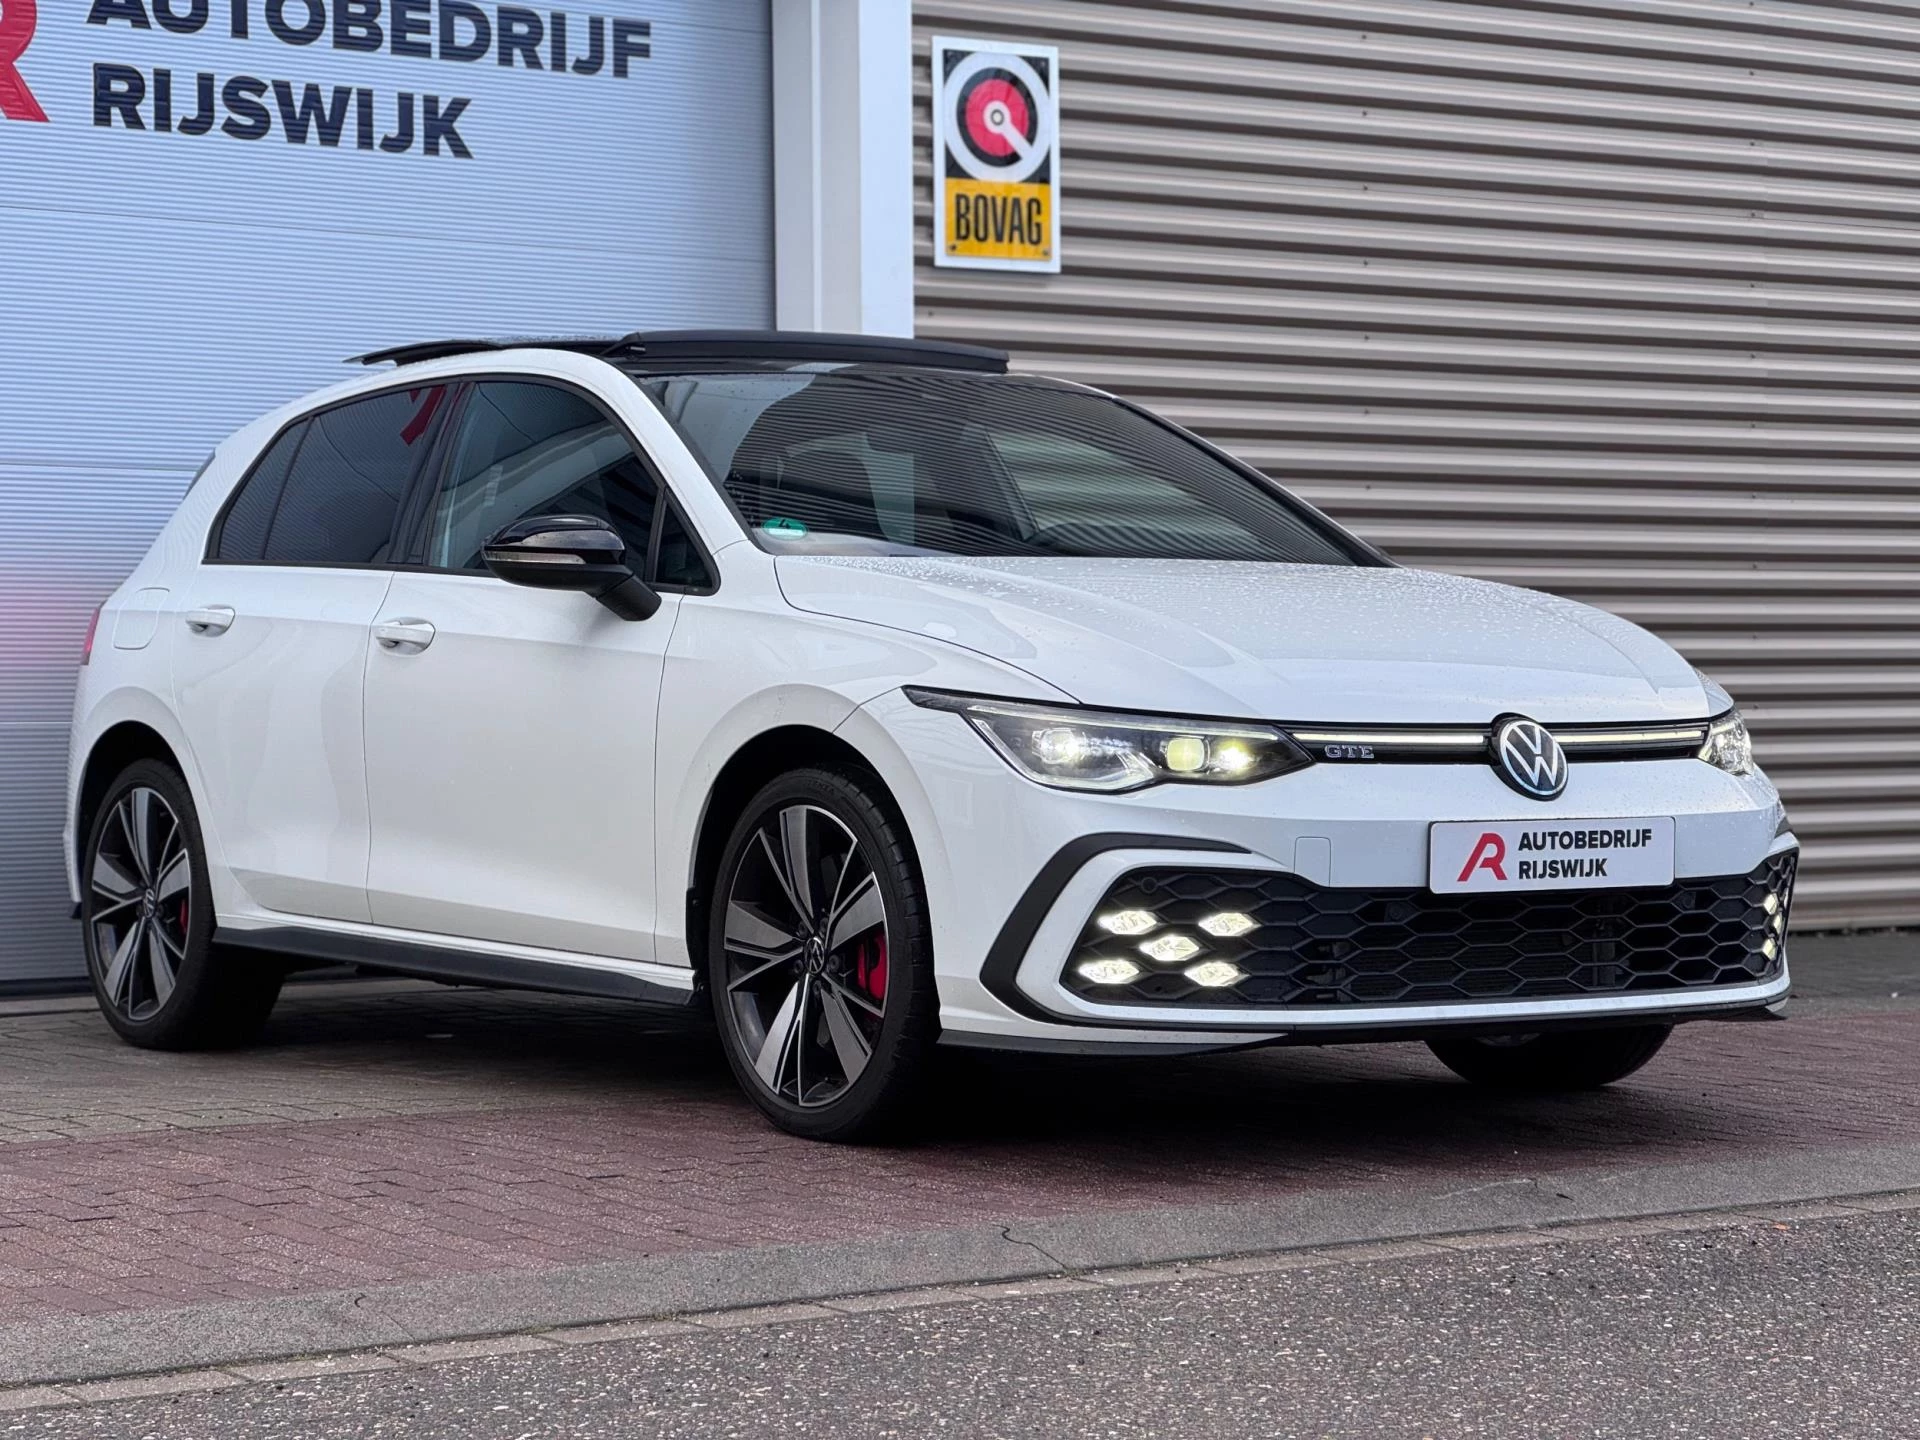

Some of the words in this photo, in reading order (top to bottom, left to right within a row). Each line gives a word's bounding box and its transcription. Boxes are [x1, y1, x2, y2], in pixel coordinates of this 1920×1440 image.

[92, 62, 474, 159] RIJSWIJK
[955, 194, 1042, 245] BOVAG
[1324, 744, 1375, 759] GTE
[1518, 829, 1652, 851] AUTOBEDRIJF
[1518, 858, 1607, 879] RIJSWIJK
